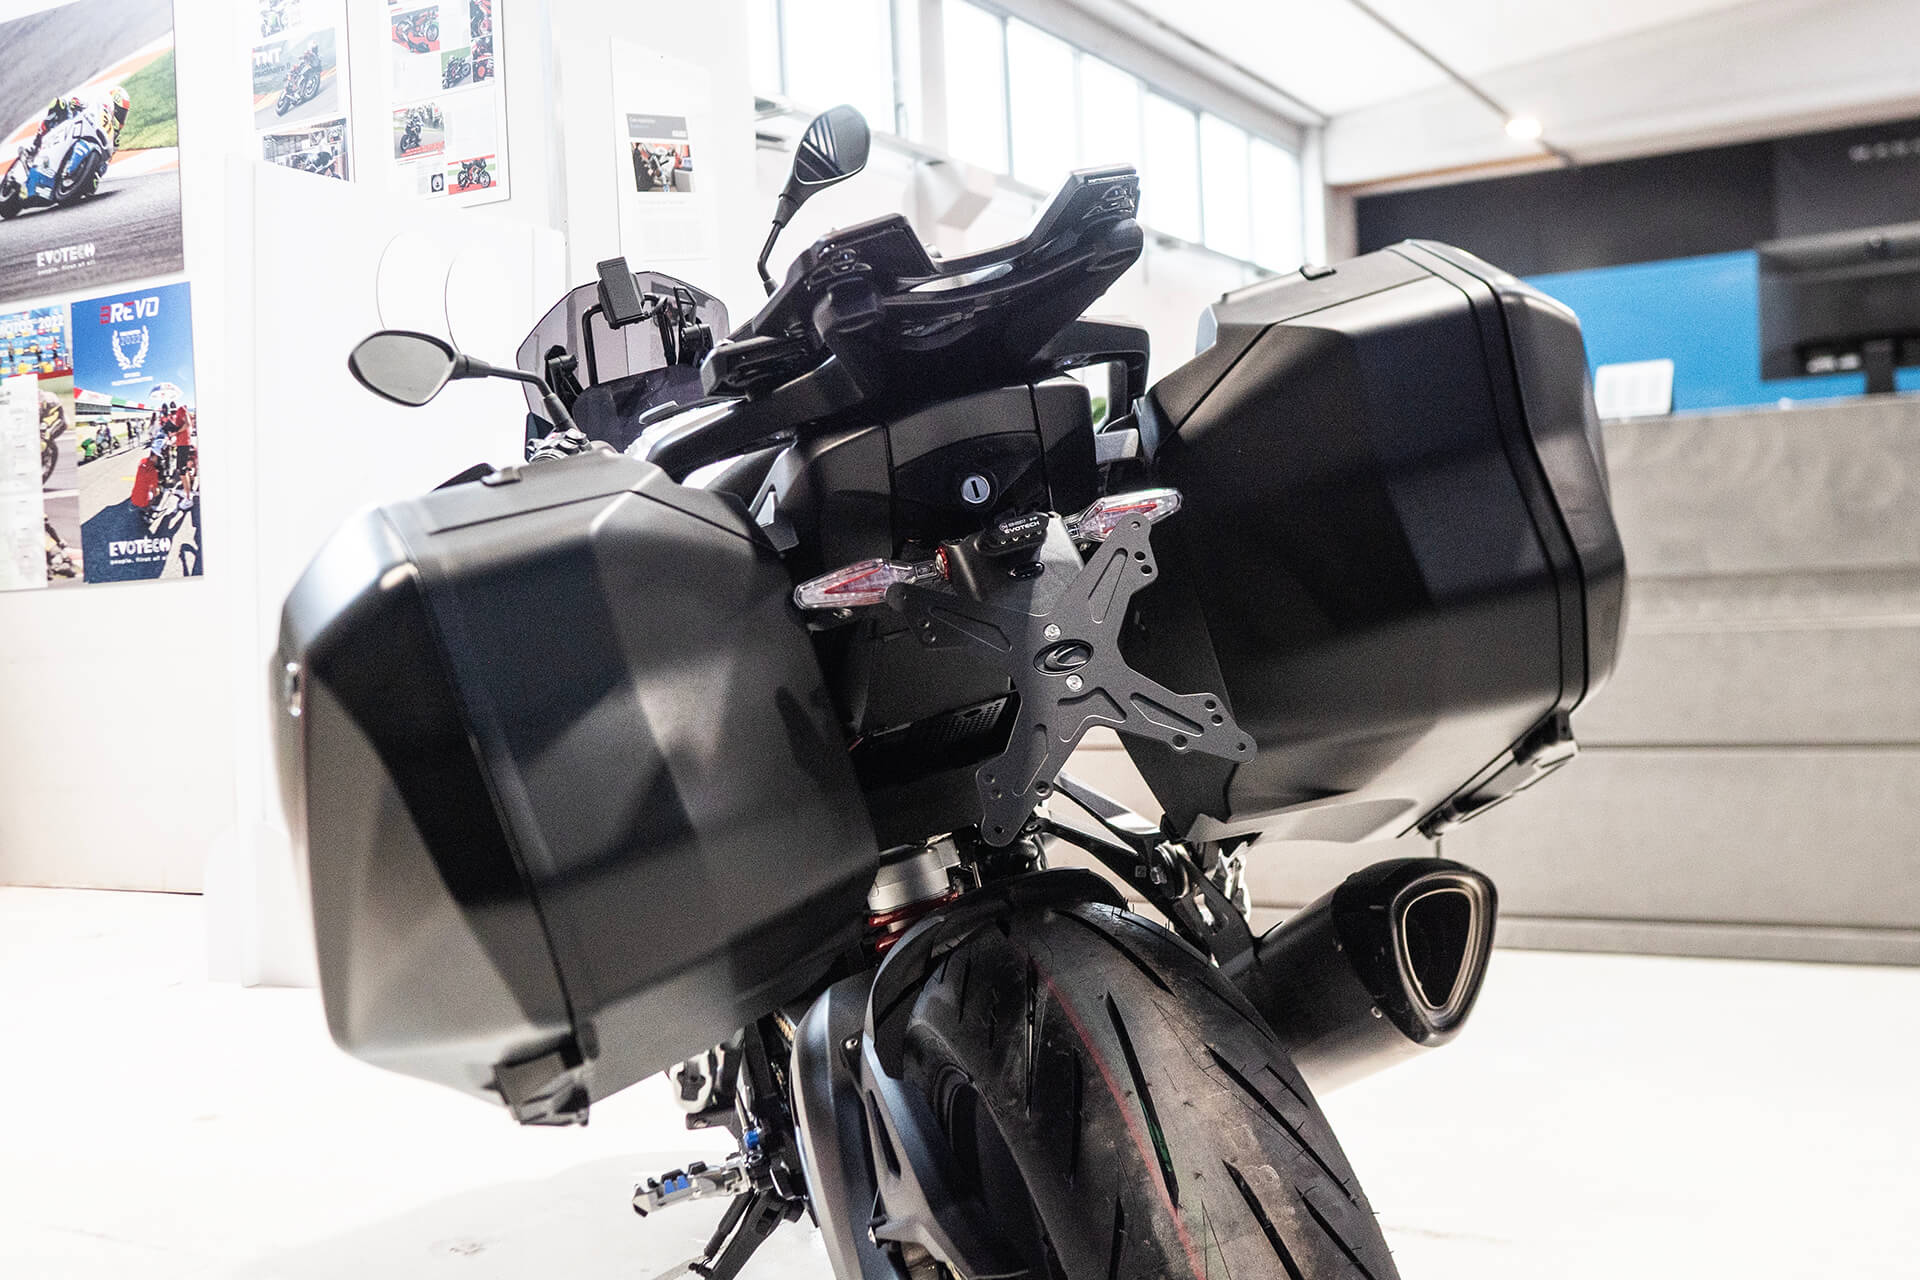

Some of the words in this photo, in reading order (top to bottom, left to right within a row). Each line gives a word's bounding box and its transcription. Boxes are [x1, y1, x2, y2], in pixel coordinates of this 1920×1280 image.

[36, 242, 96, 267] EVOTECH
[1004, 520, 1040, 534] EVOTECH
[109, 537, 171, 557] EVOTECH
